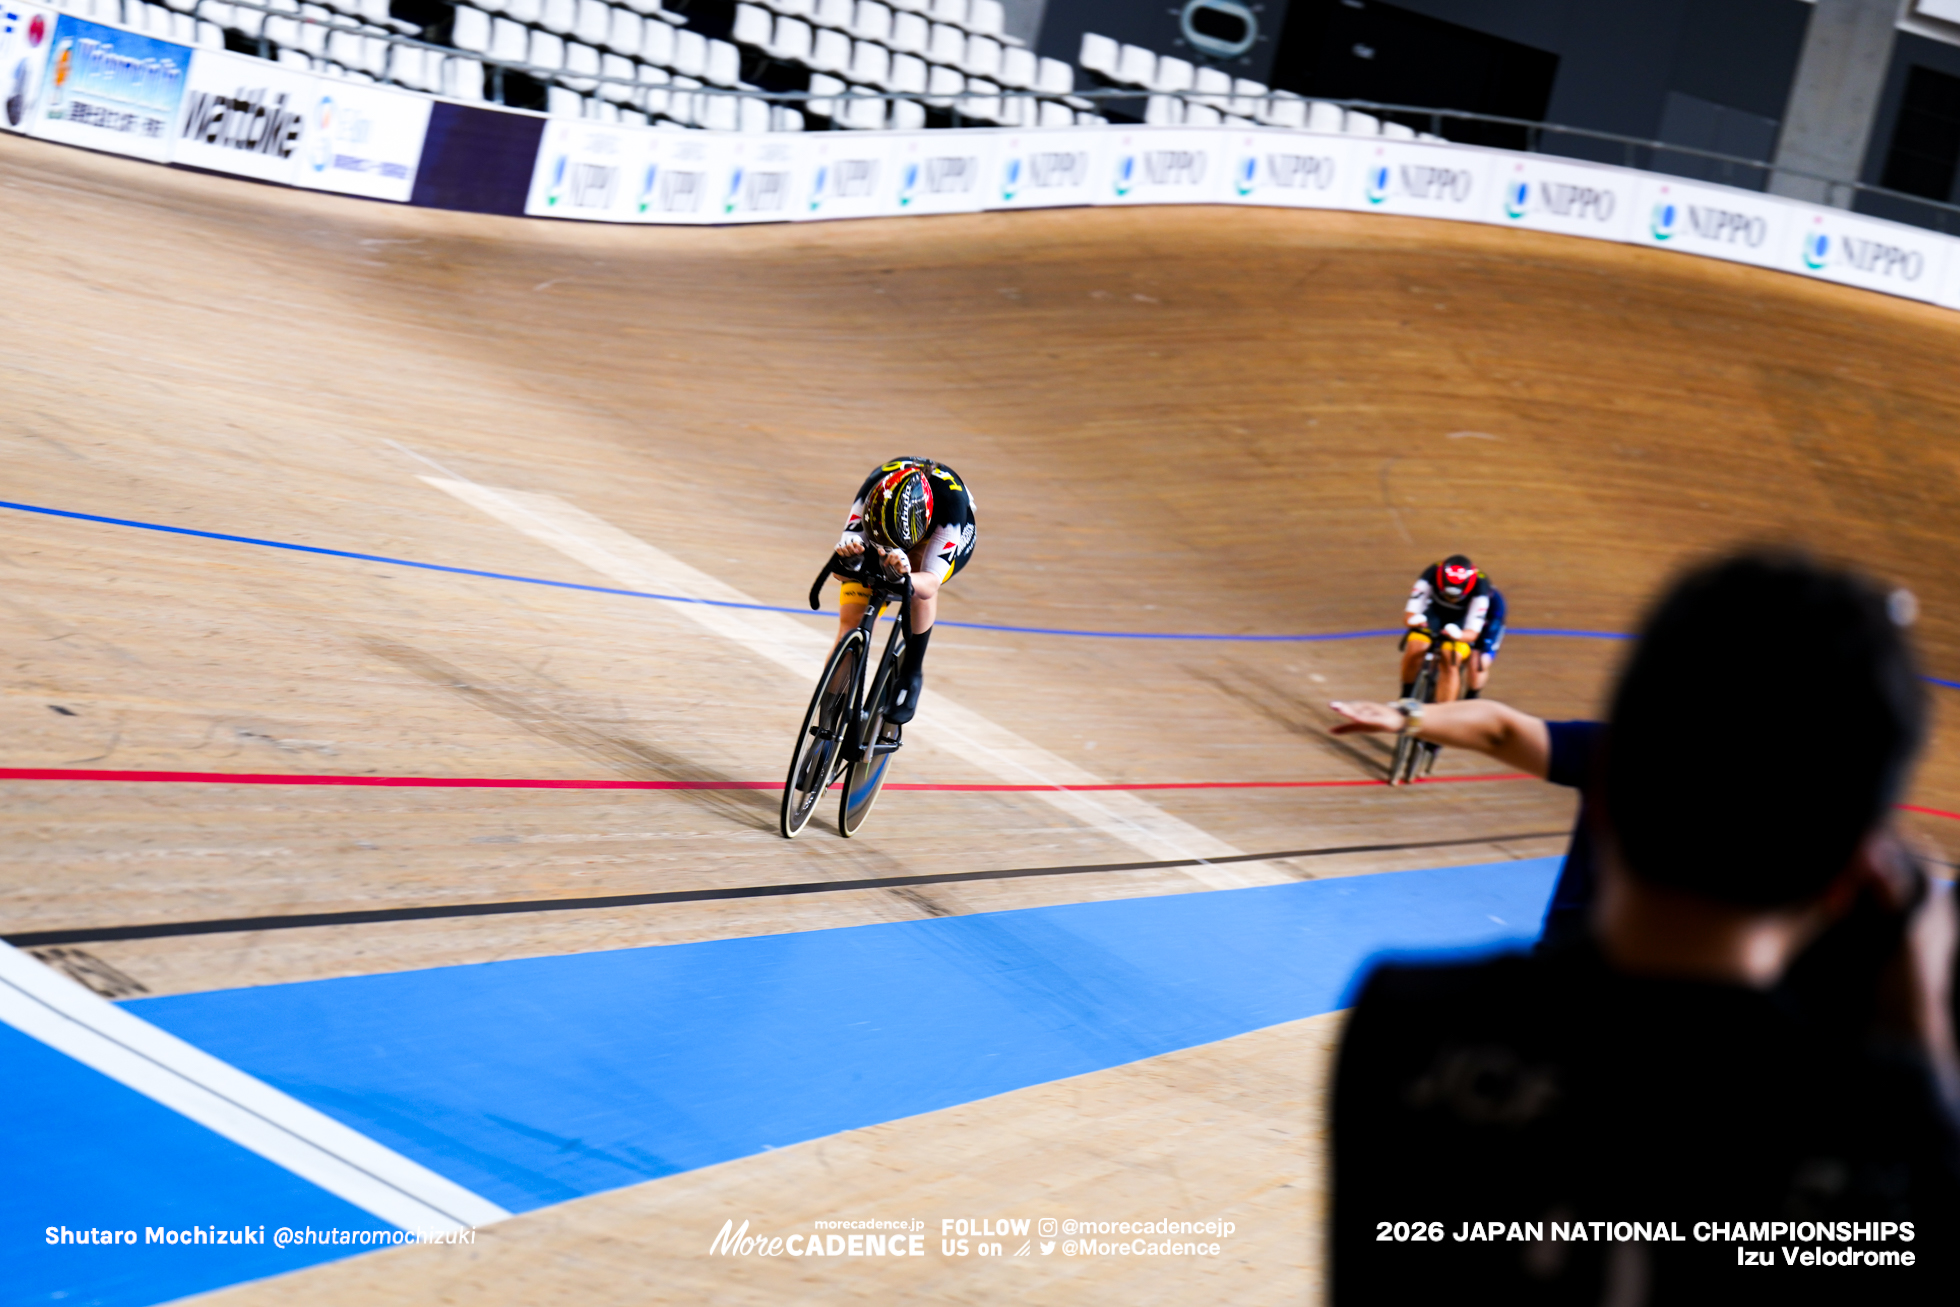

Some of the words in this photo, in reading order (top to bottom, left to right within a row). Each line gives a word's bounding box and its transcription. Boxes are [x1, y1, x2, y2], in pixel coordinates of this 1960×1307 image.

[1267, 153, 1336, 191] NIPPO
[1398, 164, 1473, 203] NIPPO
[1538, 181, 1617, 223] NIPPO
[1686, 204, 1768, 250] NIPPO
[1840, 235, 1925, 282] NIPPO
[901, 484, 912, 540] Kabuto
